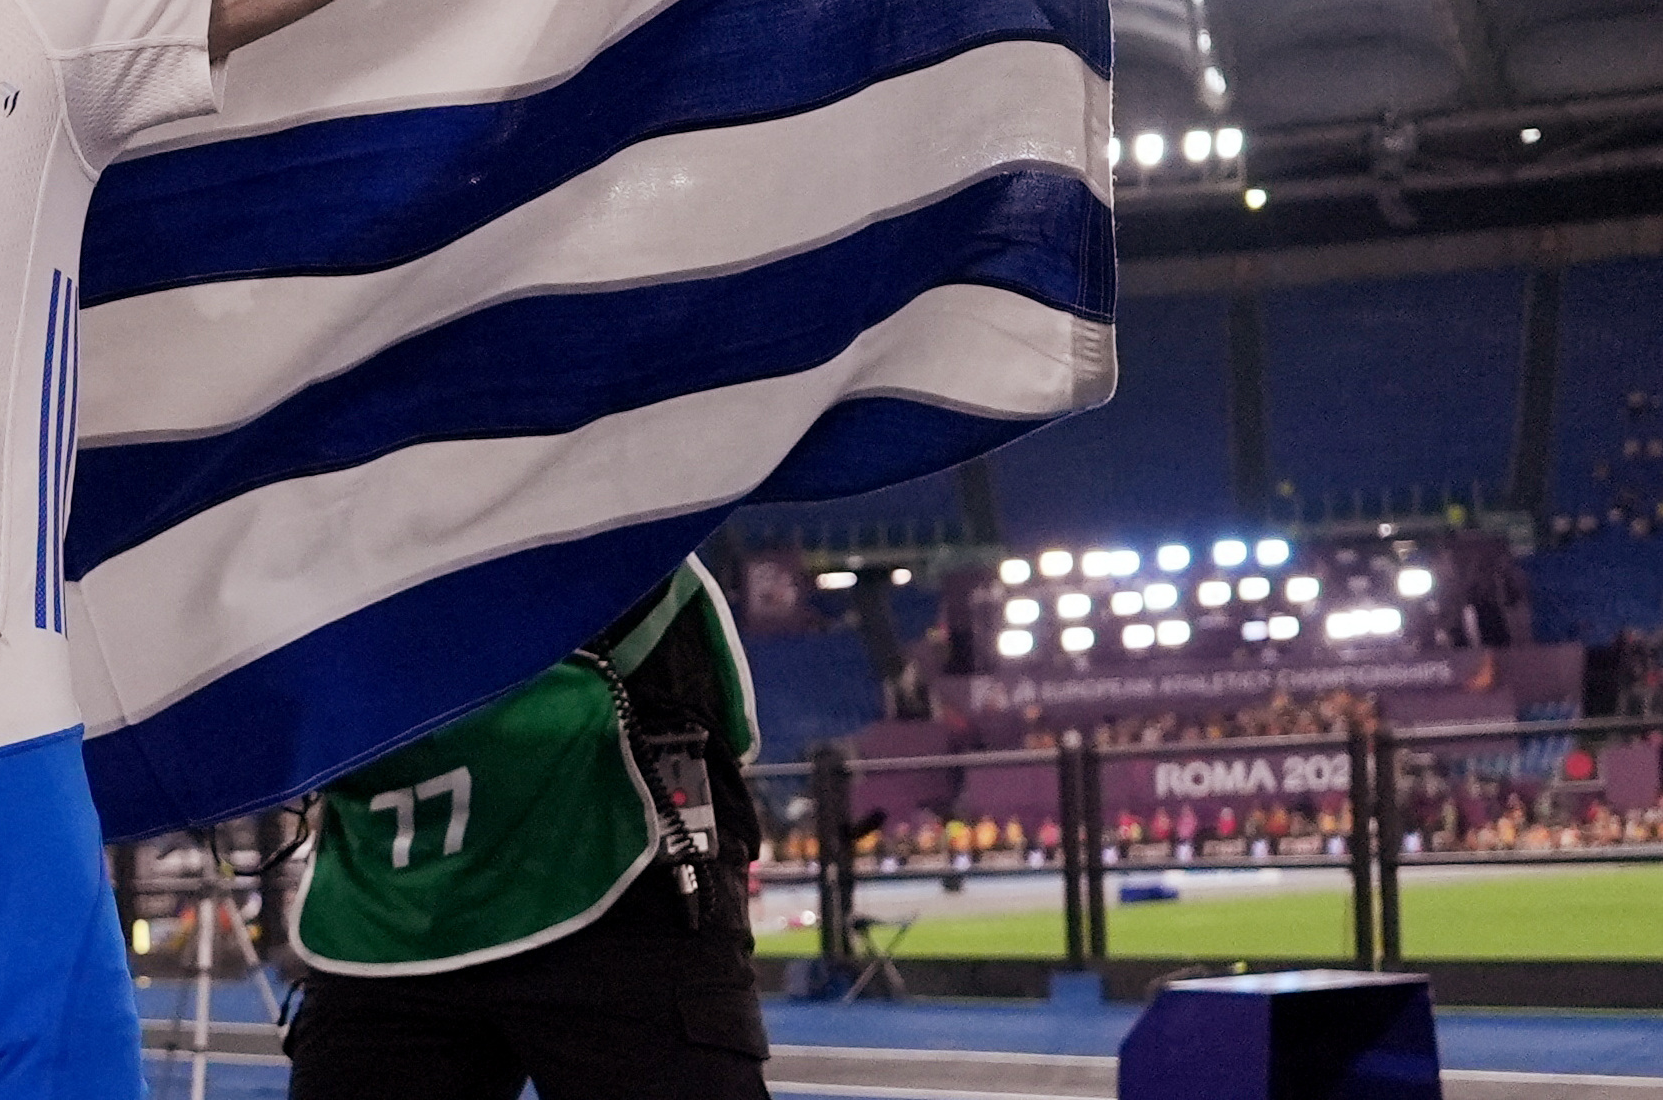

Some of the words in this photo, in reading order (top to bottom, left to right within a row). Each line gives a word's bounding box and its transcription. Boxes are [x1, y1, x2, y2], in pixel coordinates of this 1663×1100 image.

[1154, 758, 1278, 798] ROMA
[1282, 752, 1352, 793] 202
[369, 766, 472, 869] 77
